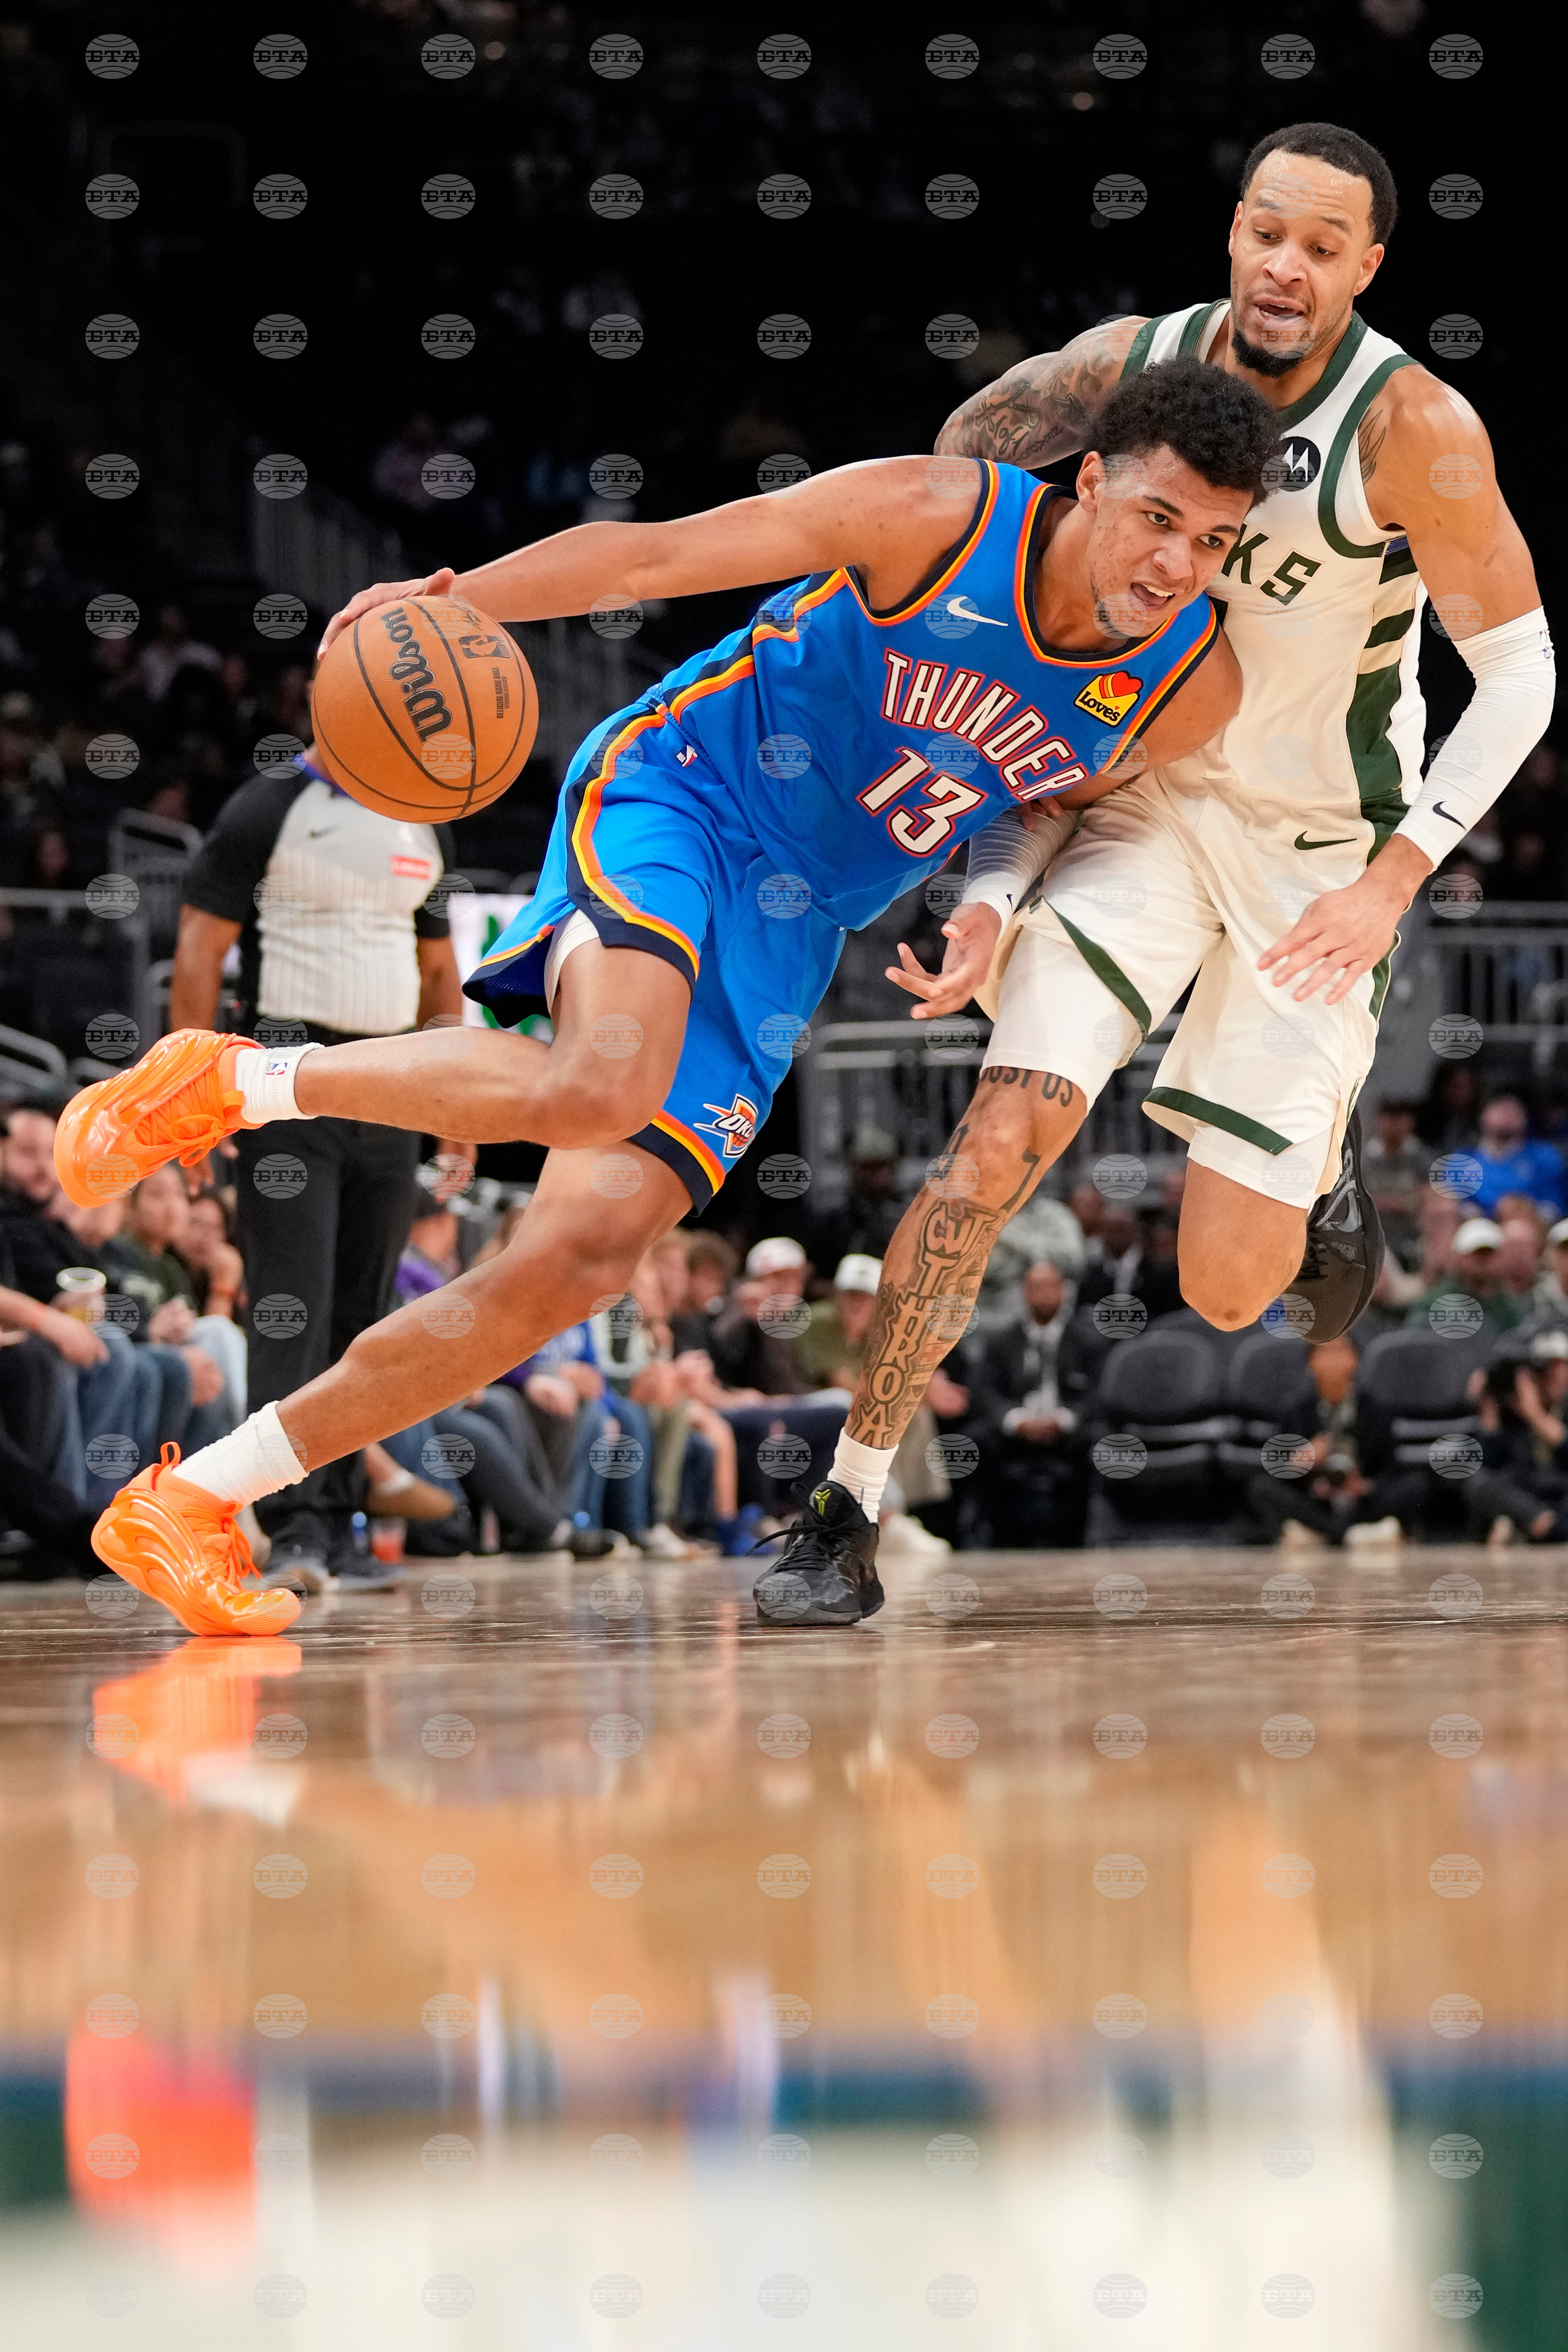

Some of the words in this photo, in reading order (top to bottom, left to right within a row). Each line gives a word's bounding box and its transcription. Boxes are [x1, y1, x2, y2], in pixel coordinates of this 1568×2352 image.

[380, 607, 453, 743] Wilson
[881, 648, 1089, 803] THUNDER
[856, 747, 988, 857] 13
